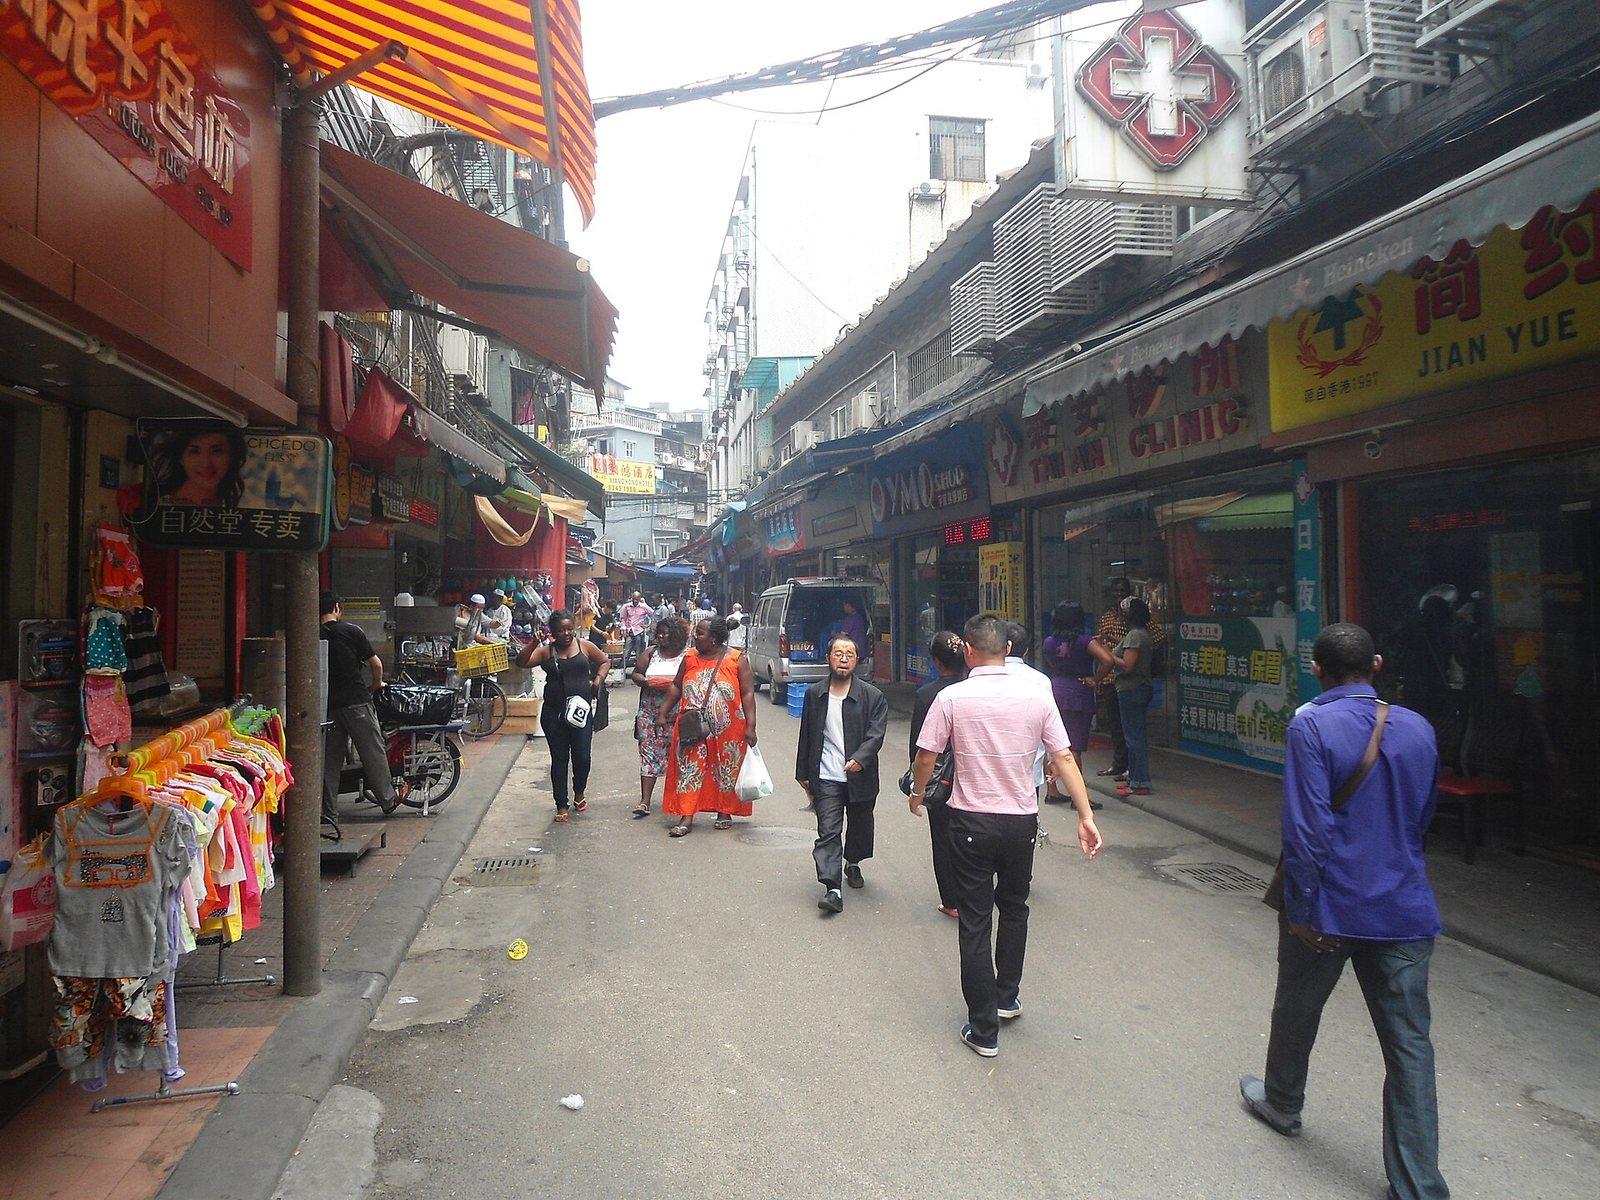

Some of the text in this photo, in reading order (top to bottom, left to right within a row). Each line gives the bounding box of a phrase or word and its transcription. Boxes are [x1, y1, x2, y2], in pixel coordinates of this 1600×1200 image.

[1323, 236, 1414, 288] Heineken
[1417, 308, 1578, 378] JIAN YUE
[247, 437, 316, 452] CHCEDO
[1129, 398, 1245, 458] CLINIC
[161, 506, 301, 541] 自然堂 专卖
